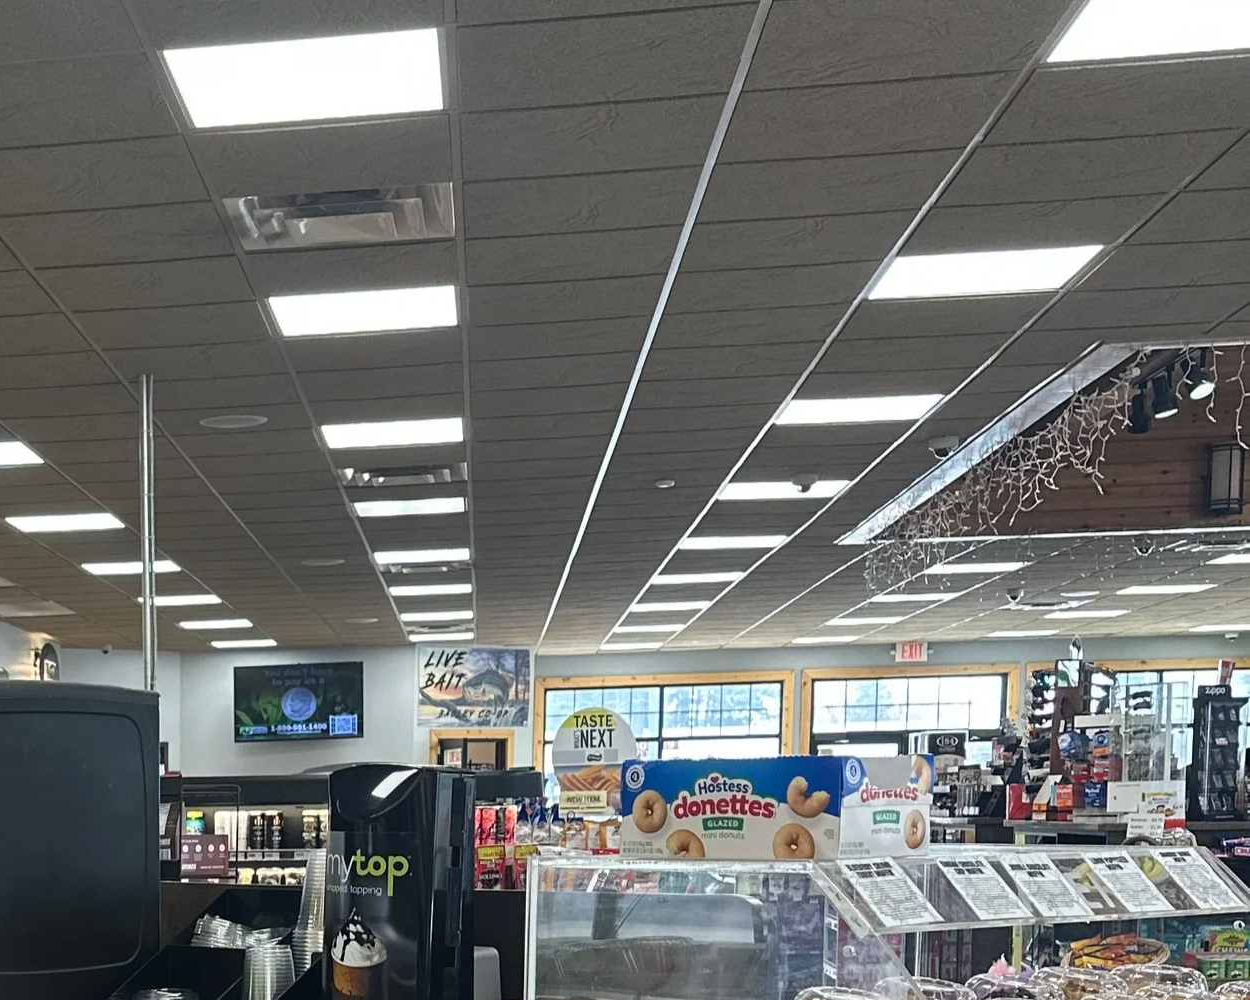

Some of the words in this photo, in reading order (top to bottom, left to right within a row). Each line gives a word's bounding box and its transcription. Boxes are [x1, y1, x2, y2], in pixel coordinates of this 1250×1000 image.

[424, 649, 467, 668] LIVE
[901, 642, 924, 660] EXIT
[420, 672, 466, 692] BAIT
[574, 714, 613, 728] TASTE
[580, 728, 616, 749] NEXT
[698, 780, 750, 795] Hostess
[584, 795, 601, 803] ITEM
[673, 795, 776, 819] donettes
[707, 819, 739, 828] GLAZED
[875, 812, 897, 821] GLAZED
[701, 831, 716, 840] mini
[716, 831, 746, 841] donuts
[327, 848, 410, 897] mytop
[350, 885, 383, 897] topping
